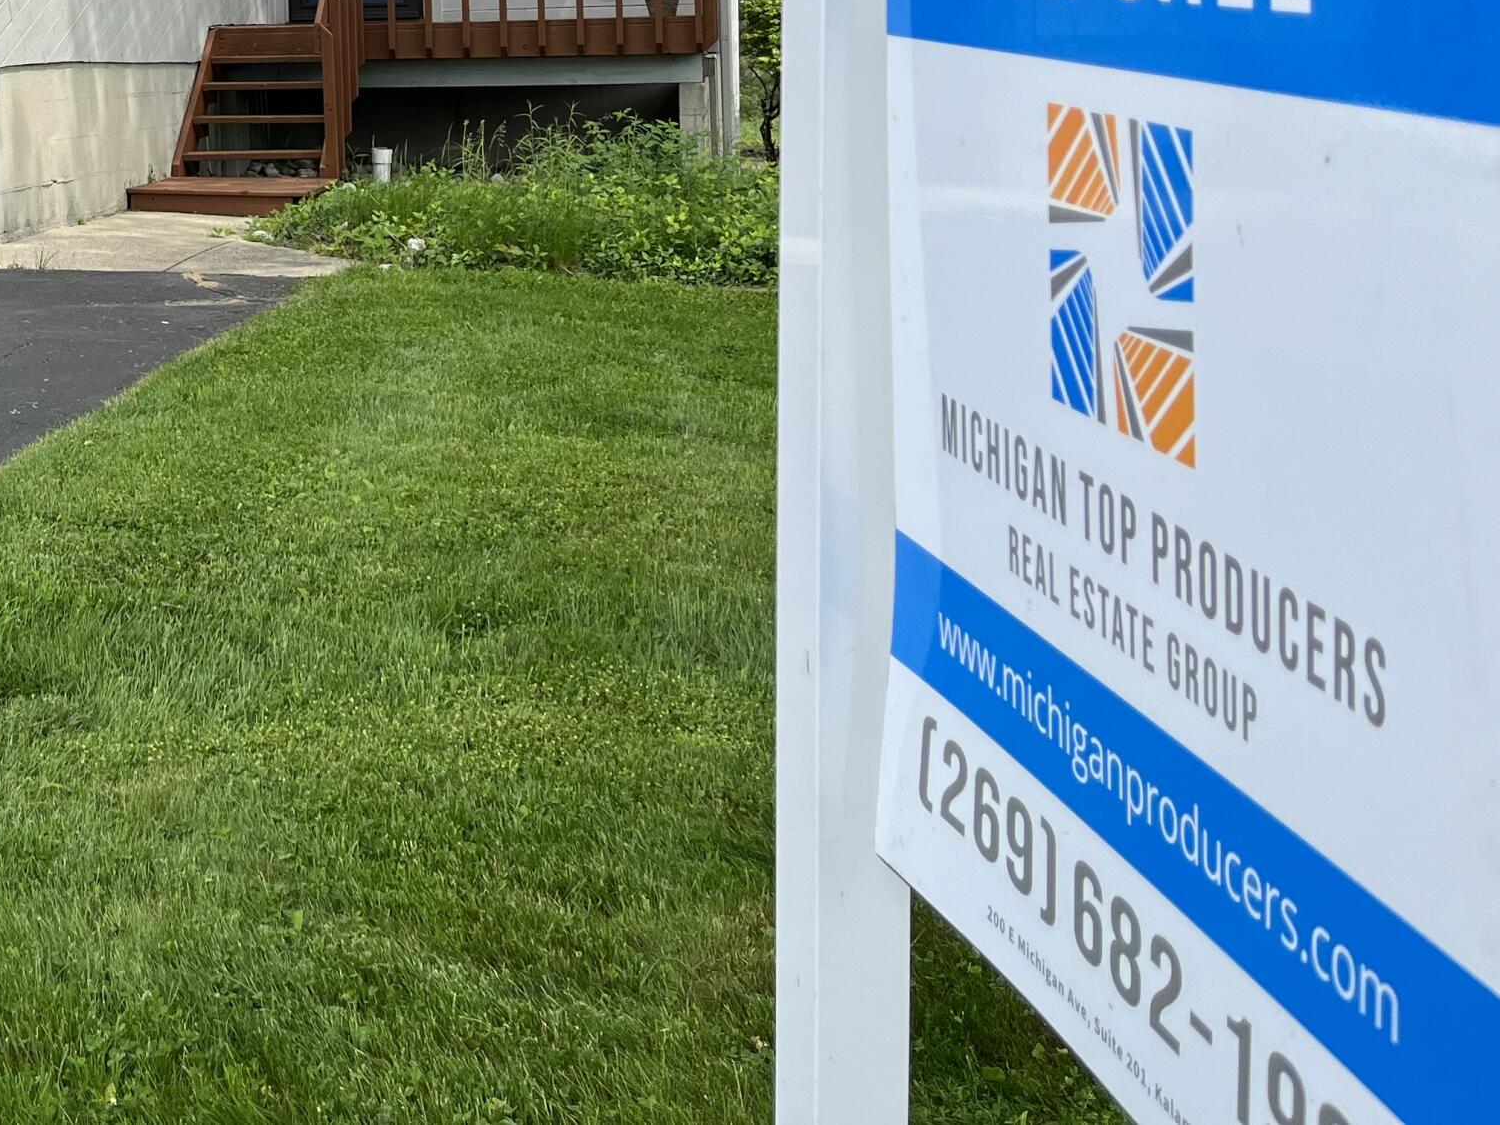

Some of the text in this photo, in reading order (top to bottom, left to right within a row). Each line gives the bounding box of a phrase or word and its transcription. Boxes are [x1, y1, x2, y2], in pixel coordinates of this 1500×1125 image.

[940, 392, 1388, 729] MICHIGAN TOP PRODUCERS
[1008, 524, 1258, 743] REAL ESTATE GROUP
[918, 715, 1351, 1125] (269) 682-19
[937, 611, 1400, 1046] www.michiganproducers.com
[986, 905, 1006, 935] 200
[1008, 927, 1015, 945] E
[1017, 934, 1065, 996] Michigan
[1066, 983, 1091, 1029] Ave,
[1094, 1017, 1123, 1061] Suite
[1126, 1052, 1151, 1097] 201,
